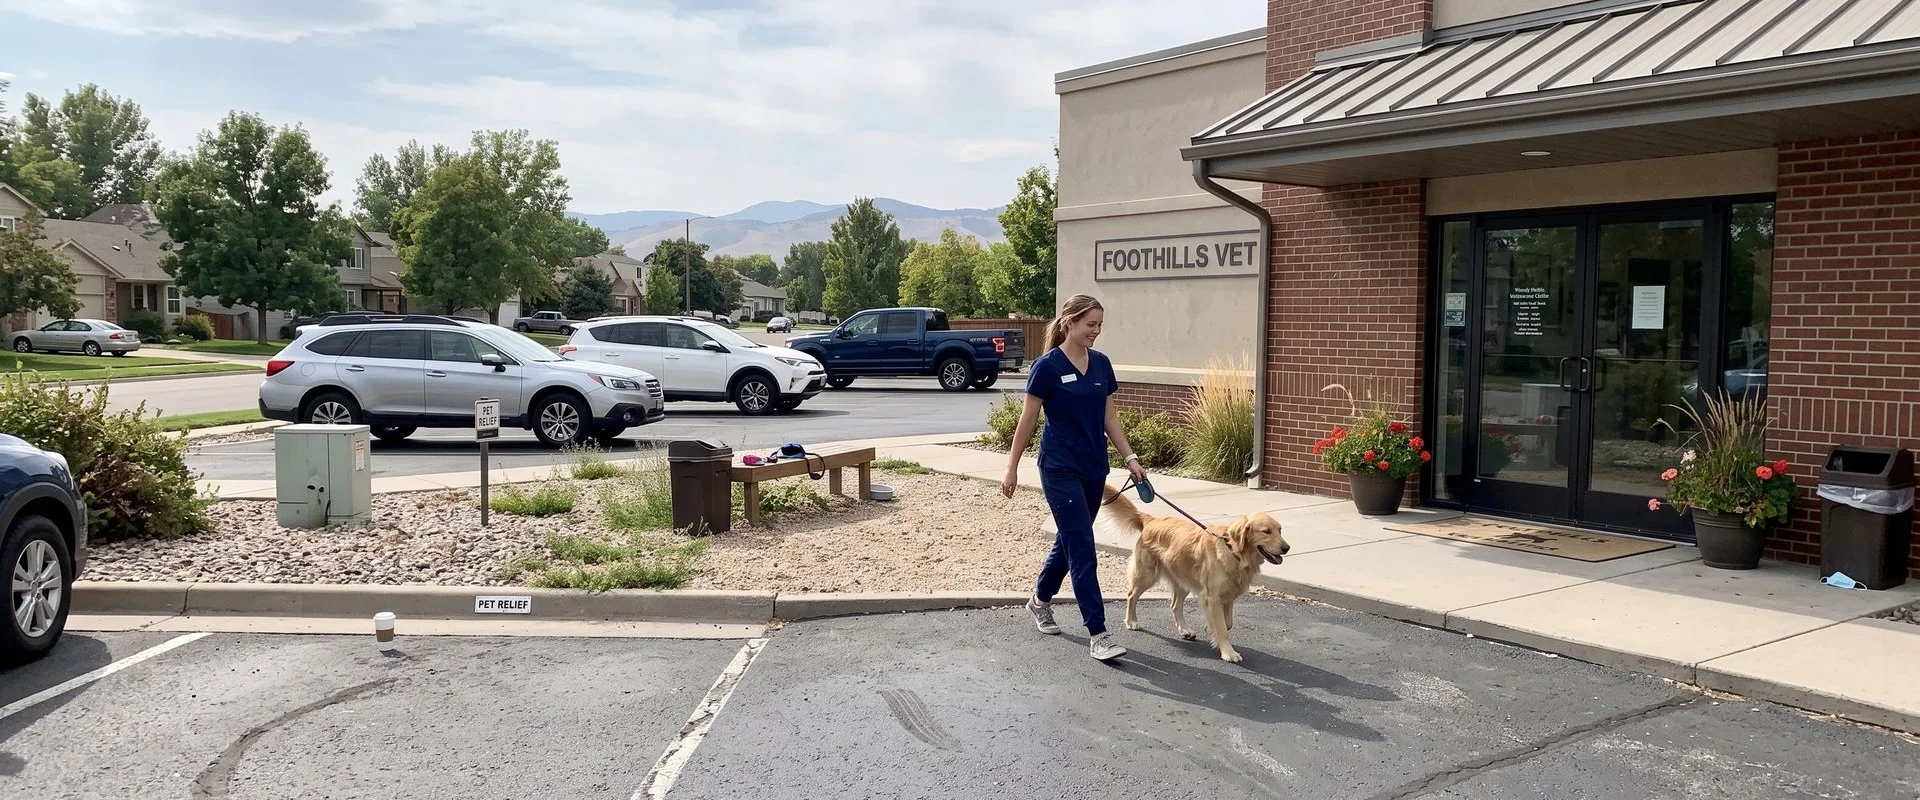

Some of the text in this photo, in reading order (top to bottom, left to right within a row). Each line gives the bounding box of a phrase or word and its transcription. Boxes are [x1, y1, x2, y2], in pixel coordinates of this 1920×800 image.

[1102, 241, 1257, 272] FOOTHILLS VET
[483, 405, 493, 415] PET
[479, 416, 497, 427] RELIEF
[478, 600, 528, 609] PET RELIEF
